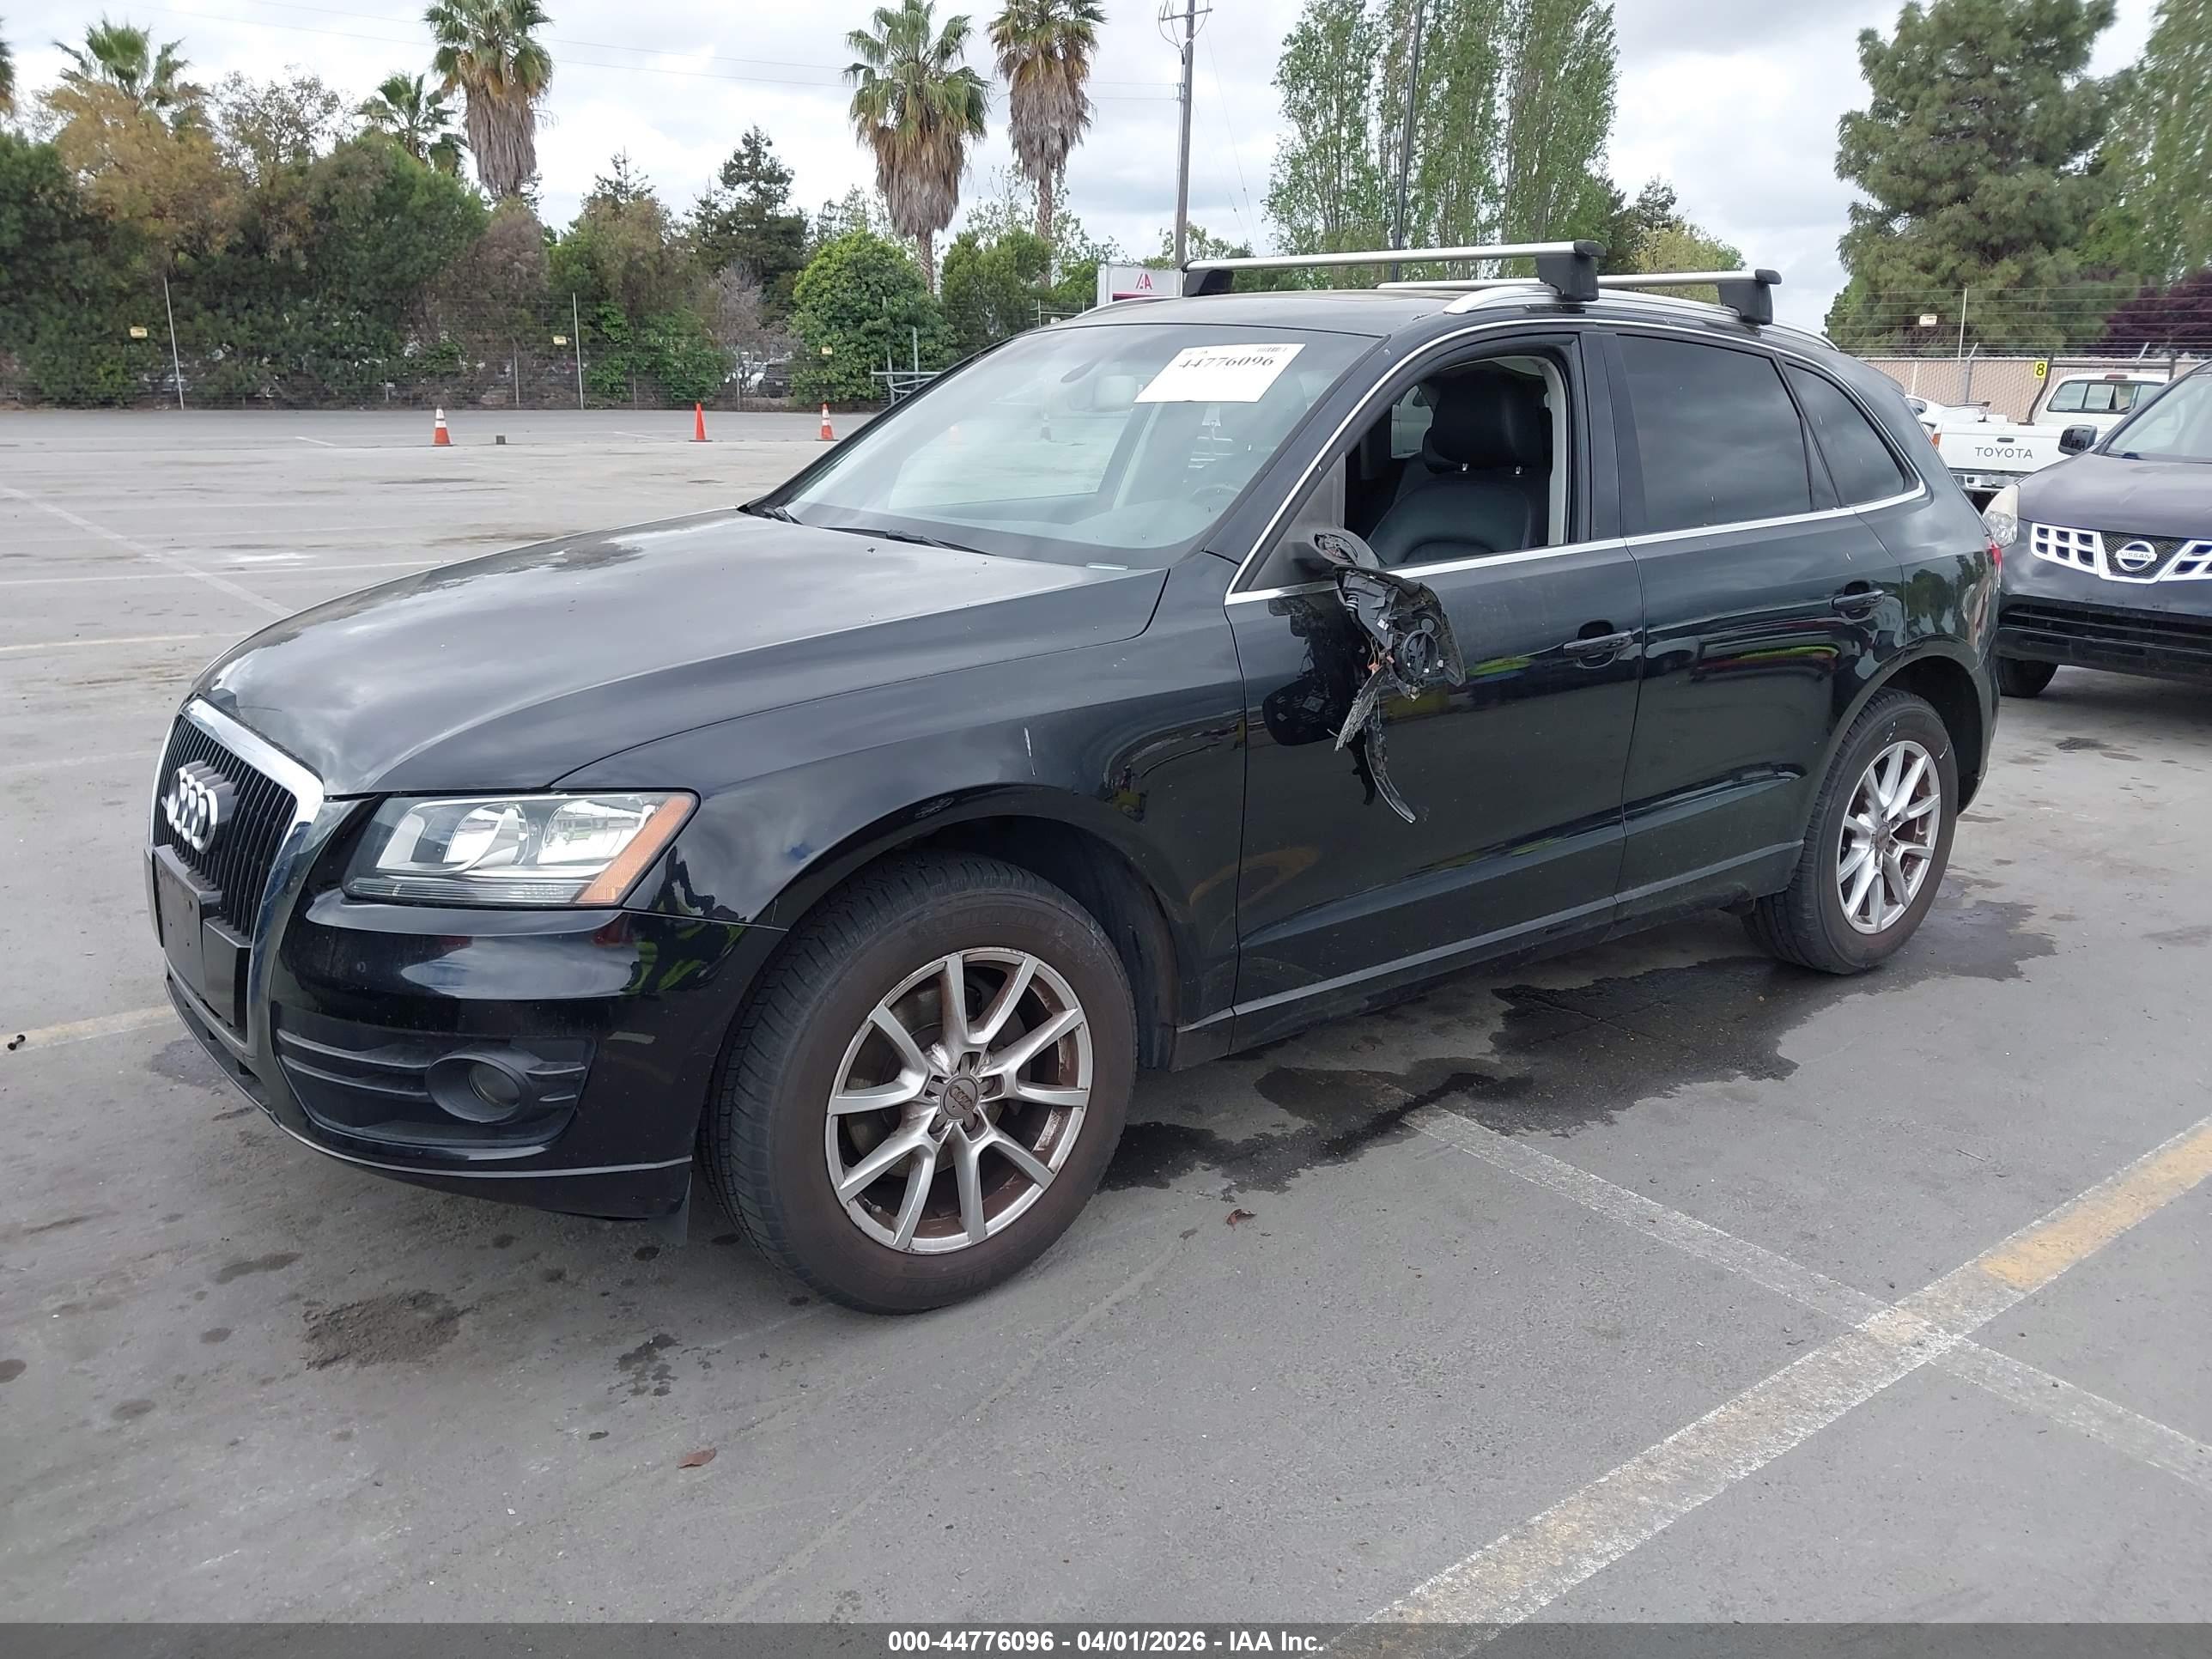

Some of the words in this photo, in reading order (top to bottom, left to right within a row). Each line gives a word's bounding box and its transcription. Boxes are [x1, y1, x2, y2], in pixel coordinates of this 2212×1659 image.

[1179, 356, 1274, 368] 44776096
[2036, 362, 2045, 376] 8
[1974, 447, 2033, 459] TOYOTA
[2120, 551, 2152, 560] NISSAN
